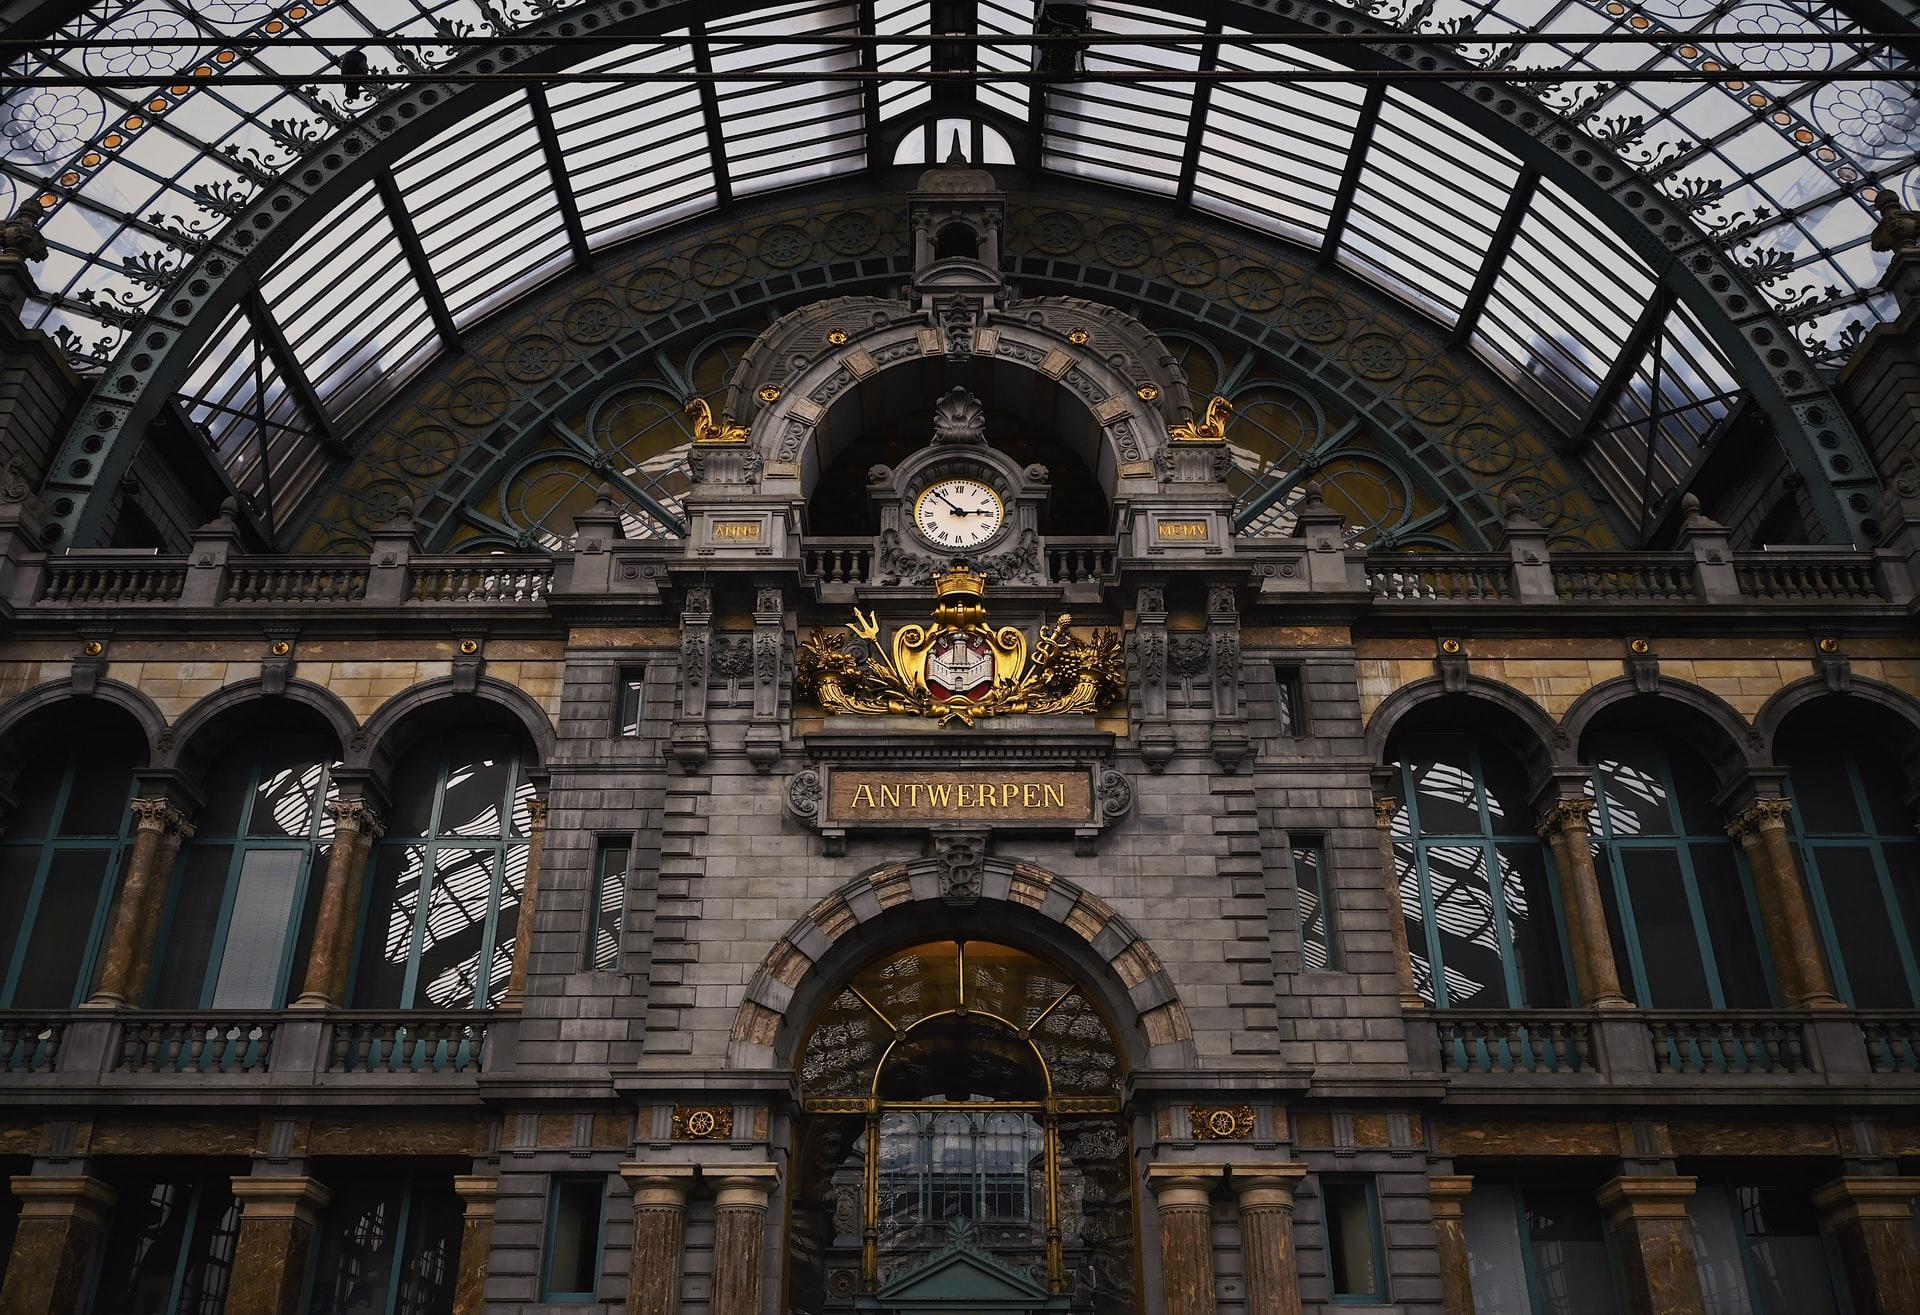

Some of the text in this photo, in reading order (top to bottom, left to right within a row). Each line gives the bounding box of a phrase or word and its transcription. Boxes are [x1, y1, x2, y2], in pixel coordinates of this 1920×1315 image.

[714, 526, 760, 536] ANNO
[1159, 525, 1206, 535] MCMV
[850, 783, 1065, 808] ANTWERPEN
